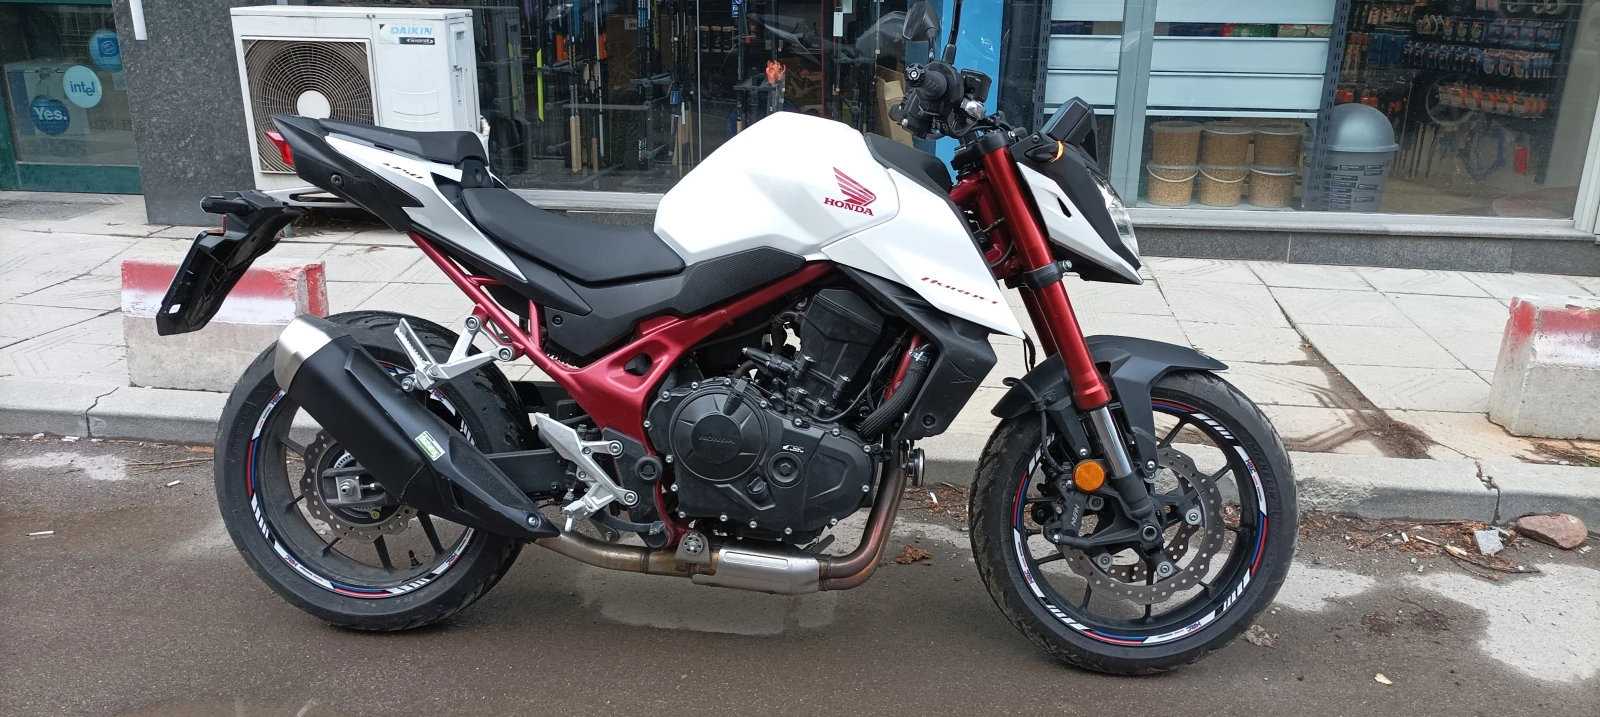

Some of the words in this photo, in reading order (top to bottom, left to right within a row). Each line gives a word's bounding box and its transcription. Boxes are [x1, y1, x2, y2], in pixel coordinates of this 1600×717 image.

[390, 26, 433, 35] DAIKIN
[69, 81, 96, 96] intel
[33, 106, 68, 121] Yes.
[823, 196, 875, 217] HONDA
[698, 434, 736, 445] HONDA
[1244, 458, 1257, 474] HRC
